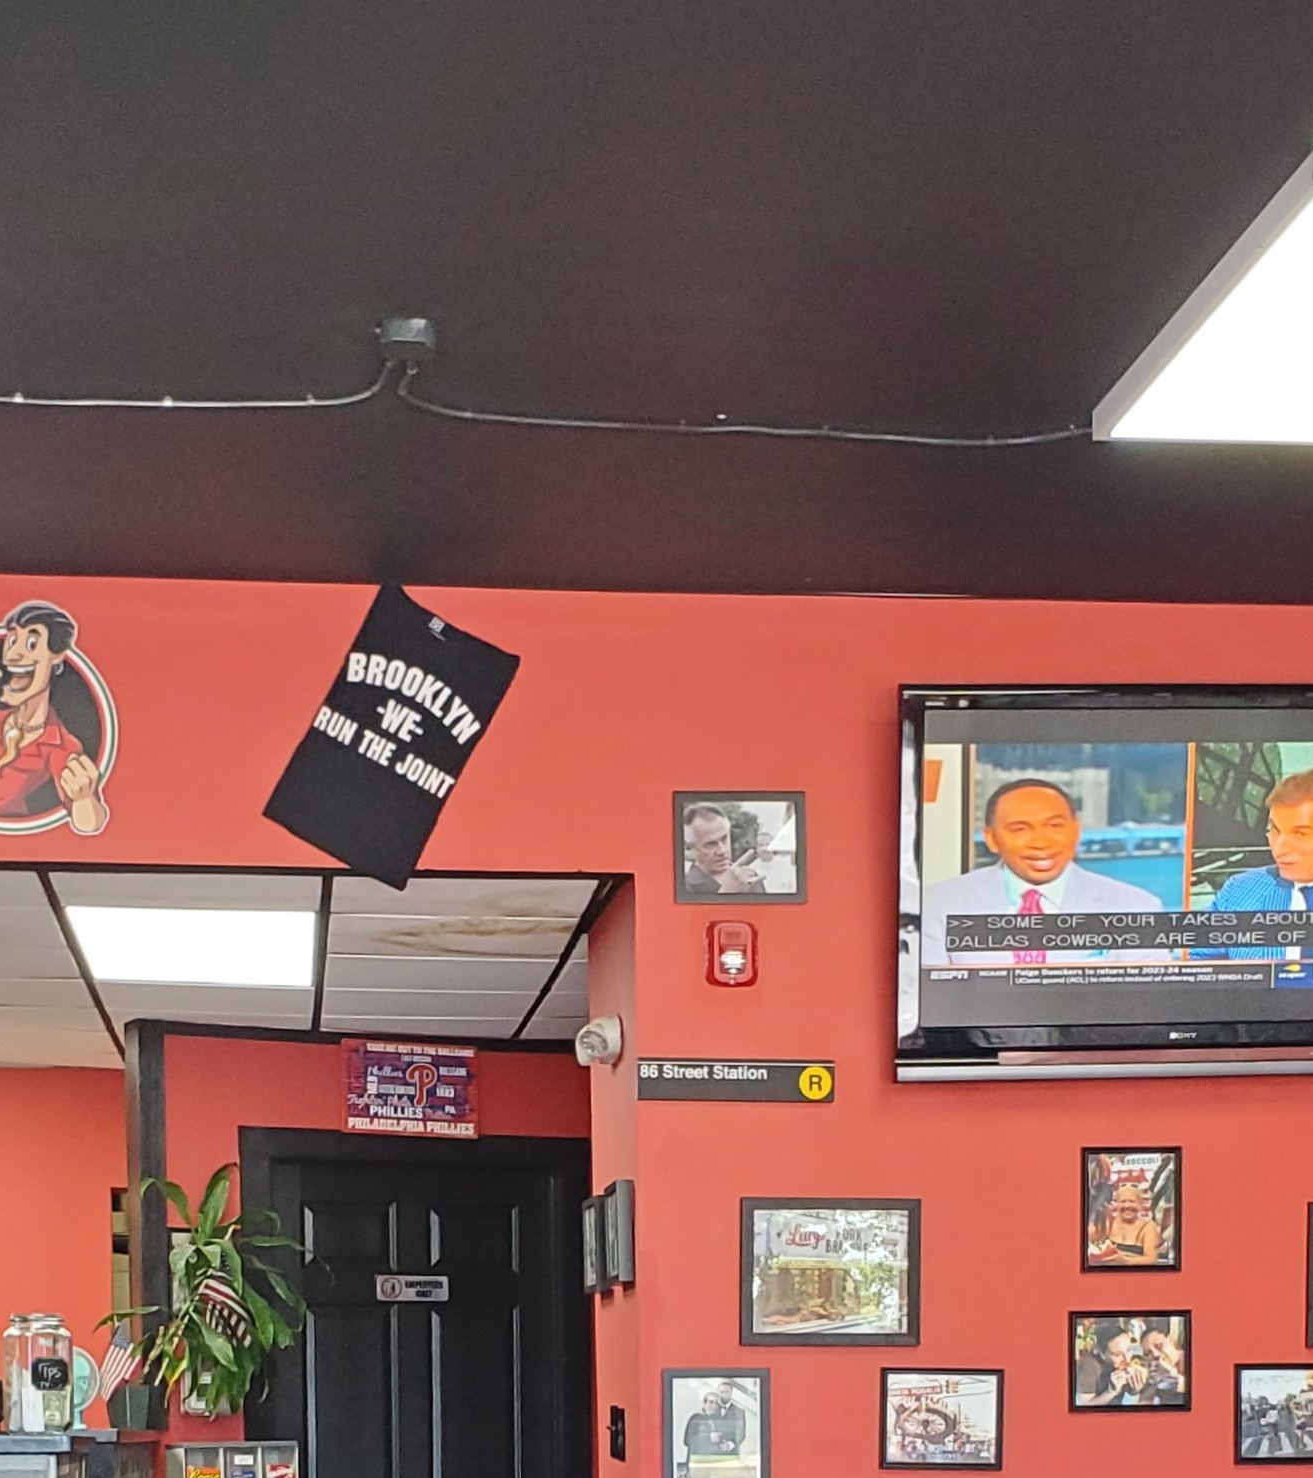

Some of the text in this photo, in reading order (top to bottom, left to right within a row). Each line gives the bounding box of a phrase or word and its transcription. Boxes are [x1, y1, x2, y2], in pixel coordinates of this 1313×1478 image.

[346, 652, 481, 745] BROOKLYN
[313, 705, 455, 799] RUN THE JOINT
[987, 916, 1044, 929] SOME
[1057, 916, 1086, 928] OF
[1100, 914, 1155, 928] YOUR
[1169, 913, 1238, 926] TAKES
[946, 935, 1029, 948] DALLAS
[1042, 933, 1140, 947] COWBOYS
[1154, 932, 1196, 945] ARE
[1208, 931, 1265, 945] SOME
[1277, 931, 1306, 944] OF
[930, 970, 968, 980] ESPN
[1086, 968, 1095, 976] to
[1097, 968, 1125, 976] return
[1127, 967, 1139, 975] for
[639, 1064, 822, 1092] 86 Street Station R
[370, 1106, 423, 1119] PHILLIES
[348, 1117, 474, 1135] PHILADELPHIA PHILLIES
